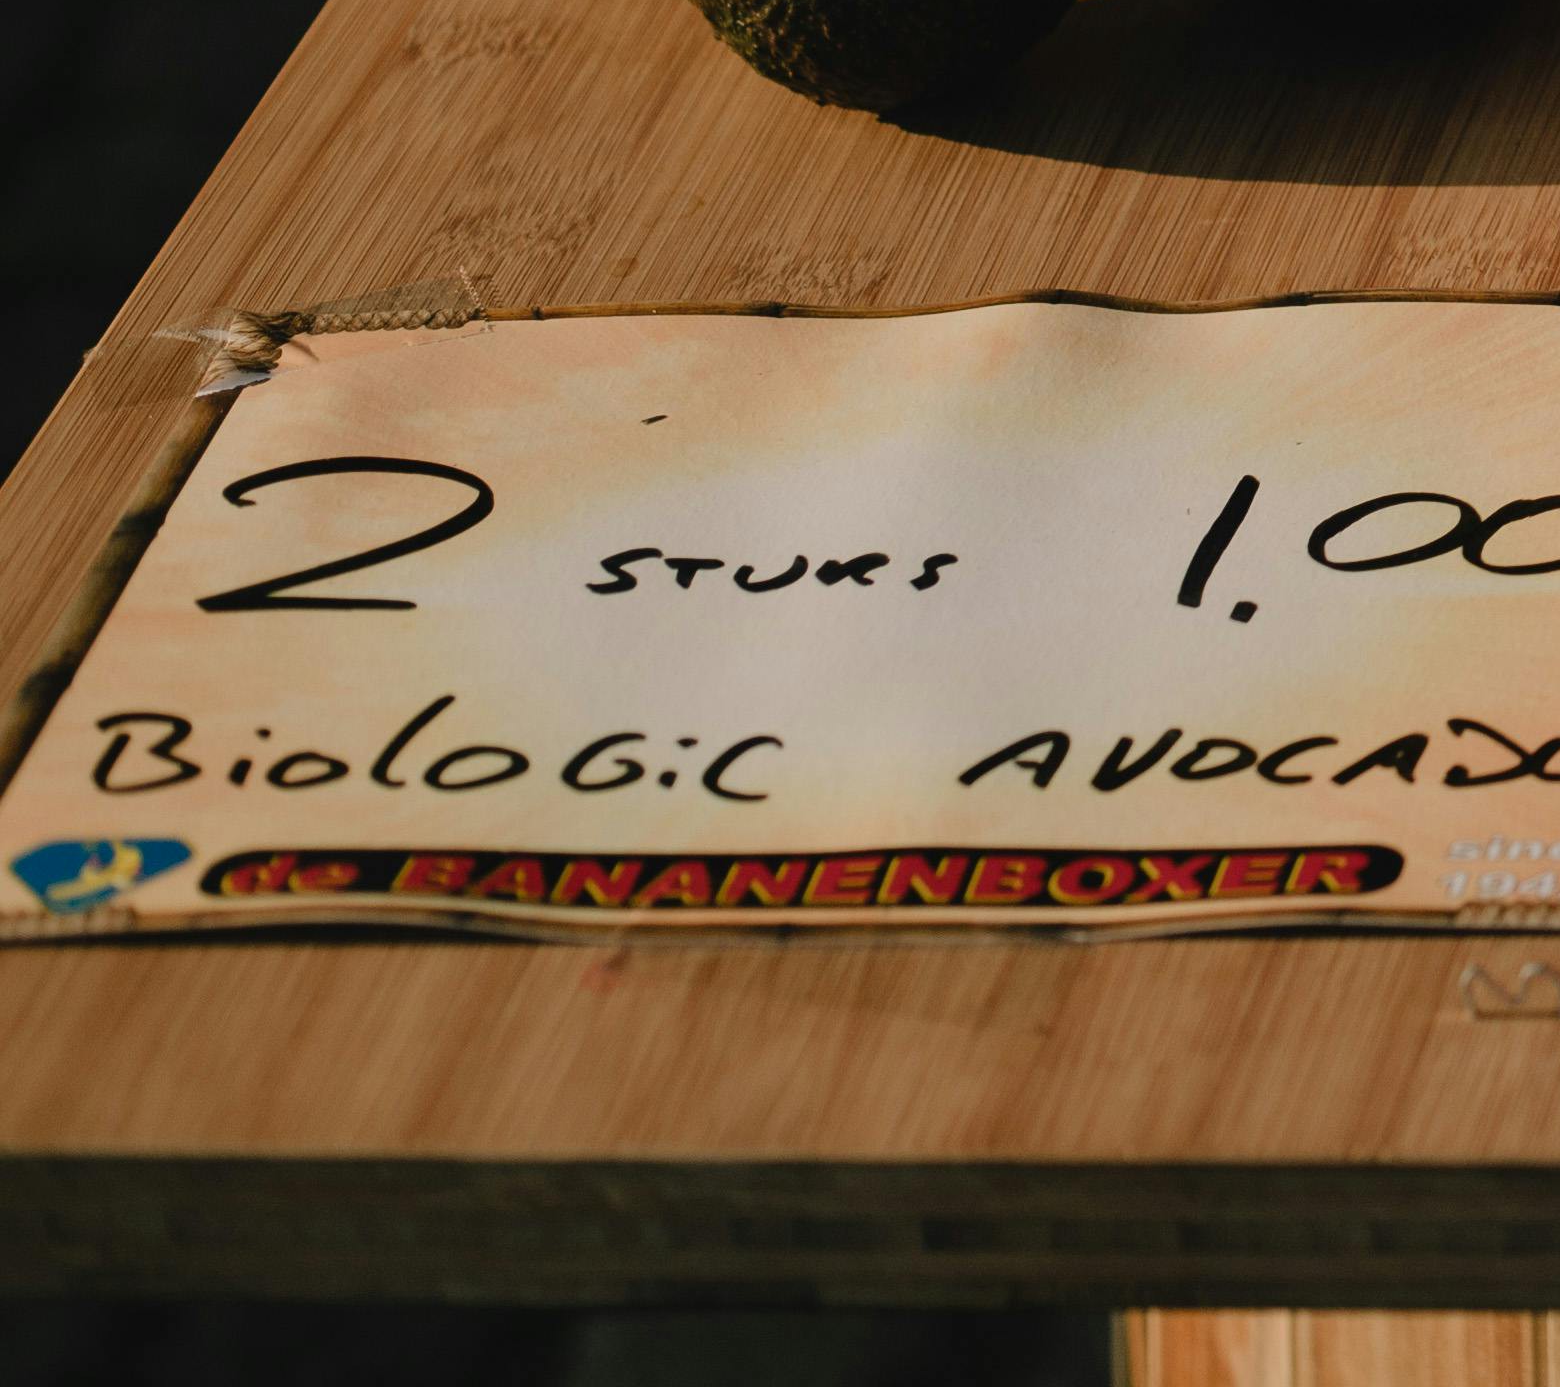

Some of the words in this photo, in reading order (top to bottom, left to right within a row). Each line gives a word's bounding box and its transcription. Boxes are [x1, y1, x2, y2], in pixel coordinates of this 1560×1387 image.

[195, 456, 495, 612] 2
[586, 548, 959, 594] STUKS
[219, 853, 362, 898] de
[390, 849, 1375, 909] BANANENBOXER
